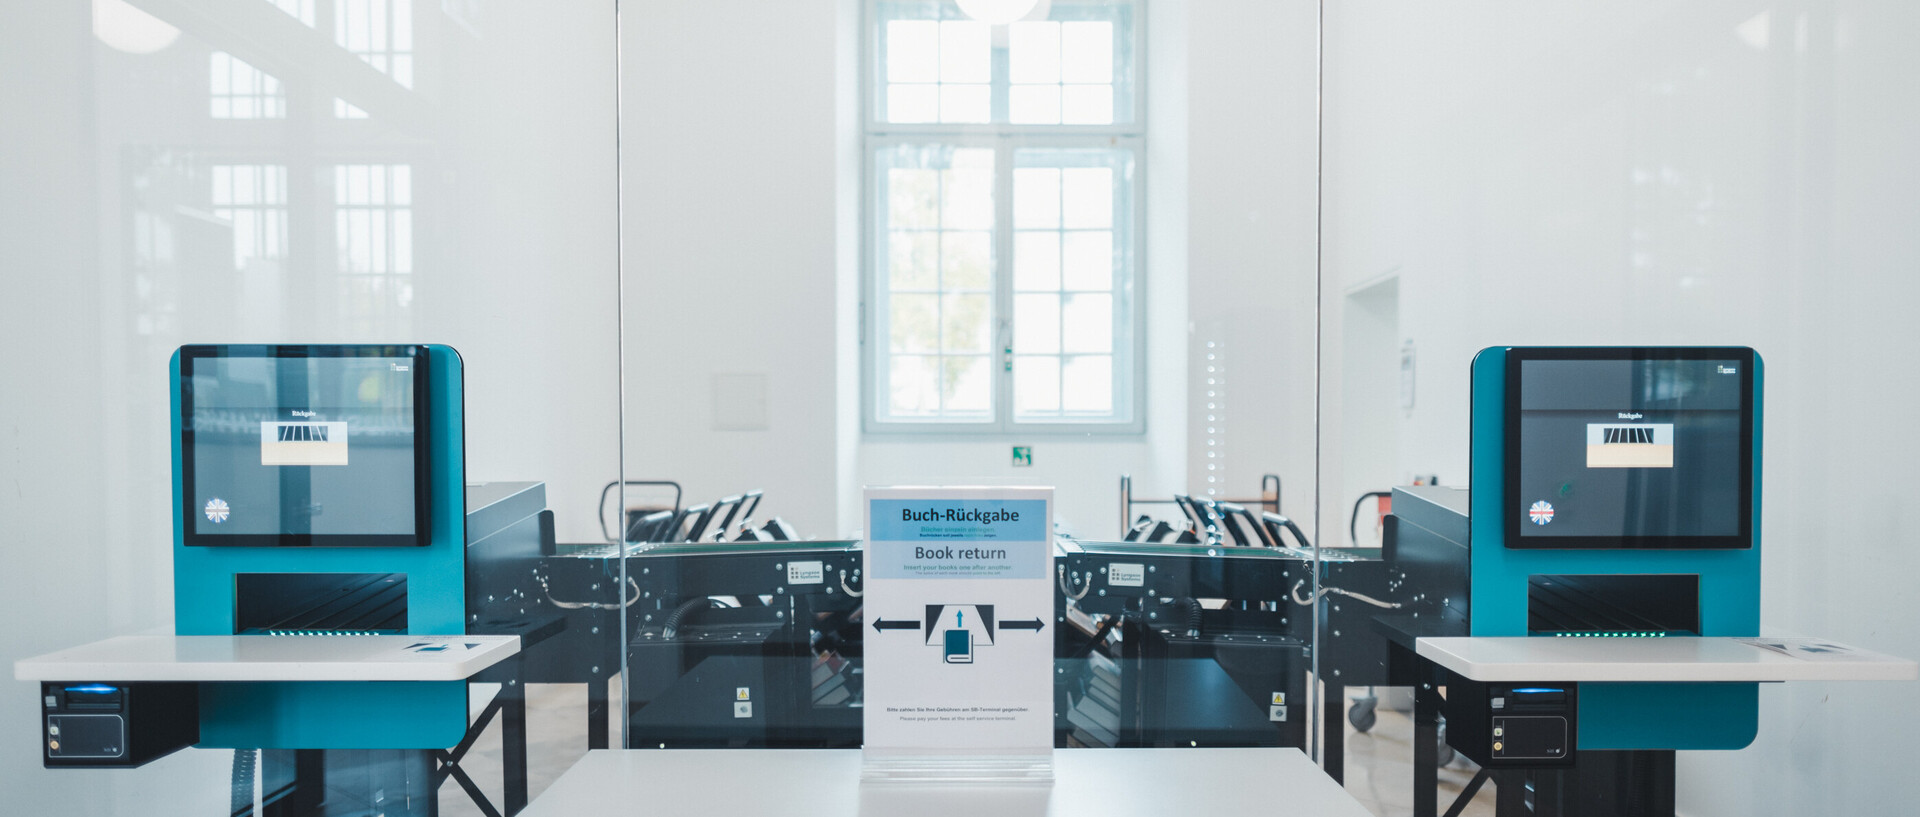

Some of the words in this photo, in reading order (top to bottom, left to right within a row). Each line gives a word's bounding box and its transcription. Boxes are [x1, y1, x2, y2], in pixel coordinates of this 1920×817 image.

[902, 508, 1020, 525] Buch-Rückgabe
[914, 546, 954, 560] Book
[958, 547, 1007, 560] return
